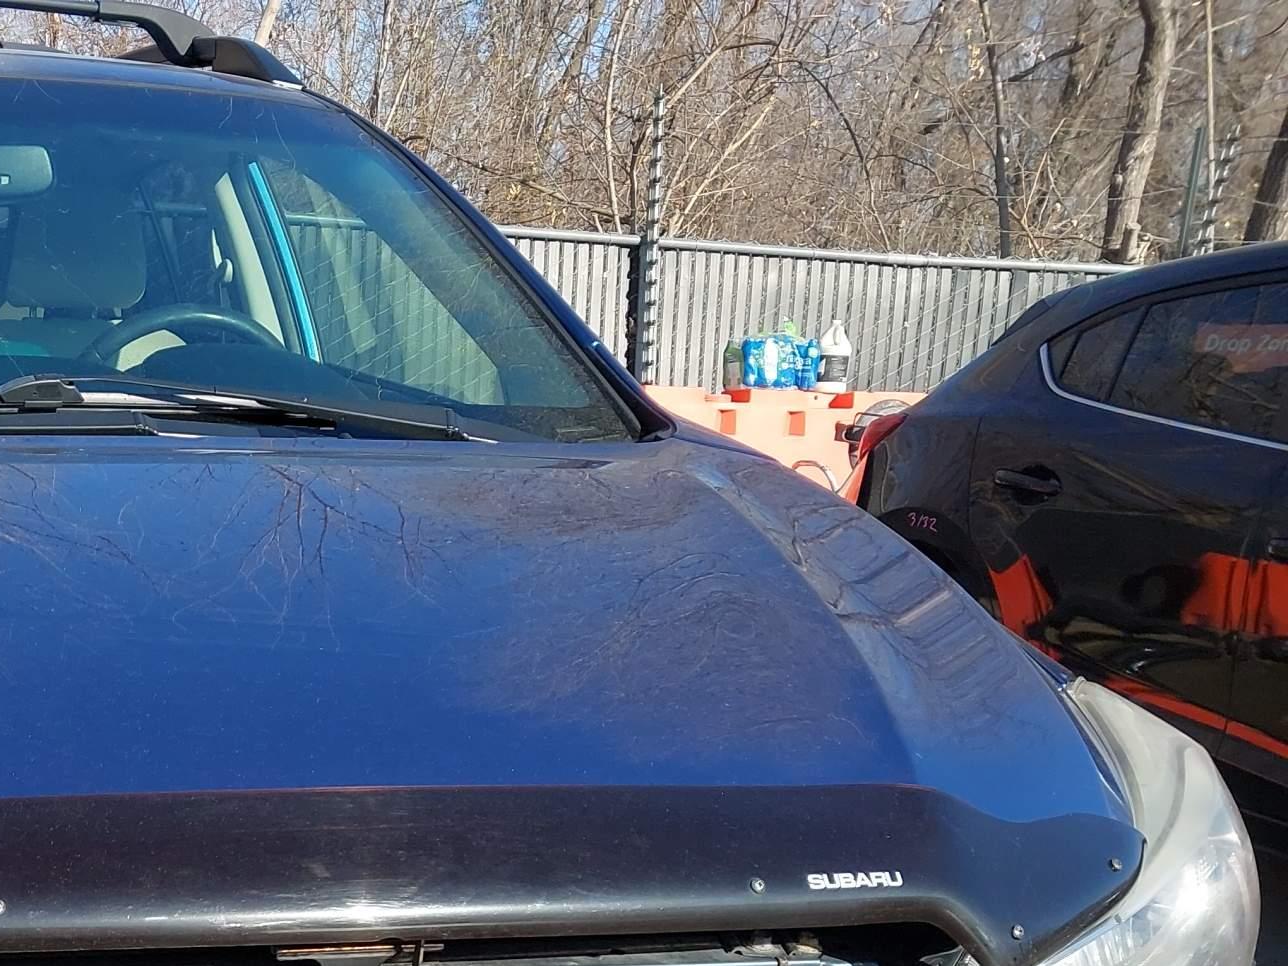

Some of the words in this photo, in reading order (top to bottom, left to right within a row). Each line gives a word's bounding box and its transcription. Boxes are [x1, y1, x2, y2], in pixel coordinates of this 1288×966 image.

[1204, 334, 1251, 354] Drop
[907, 512, 938, 532] 3/32
[807, 871, 903, 890] SUBARU
